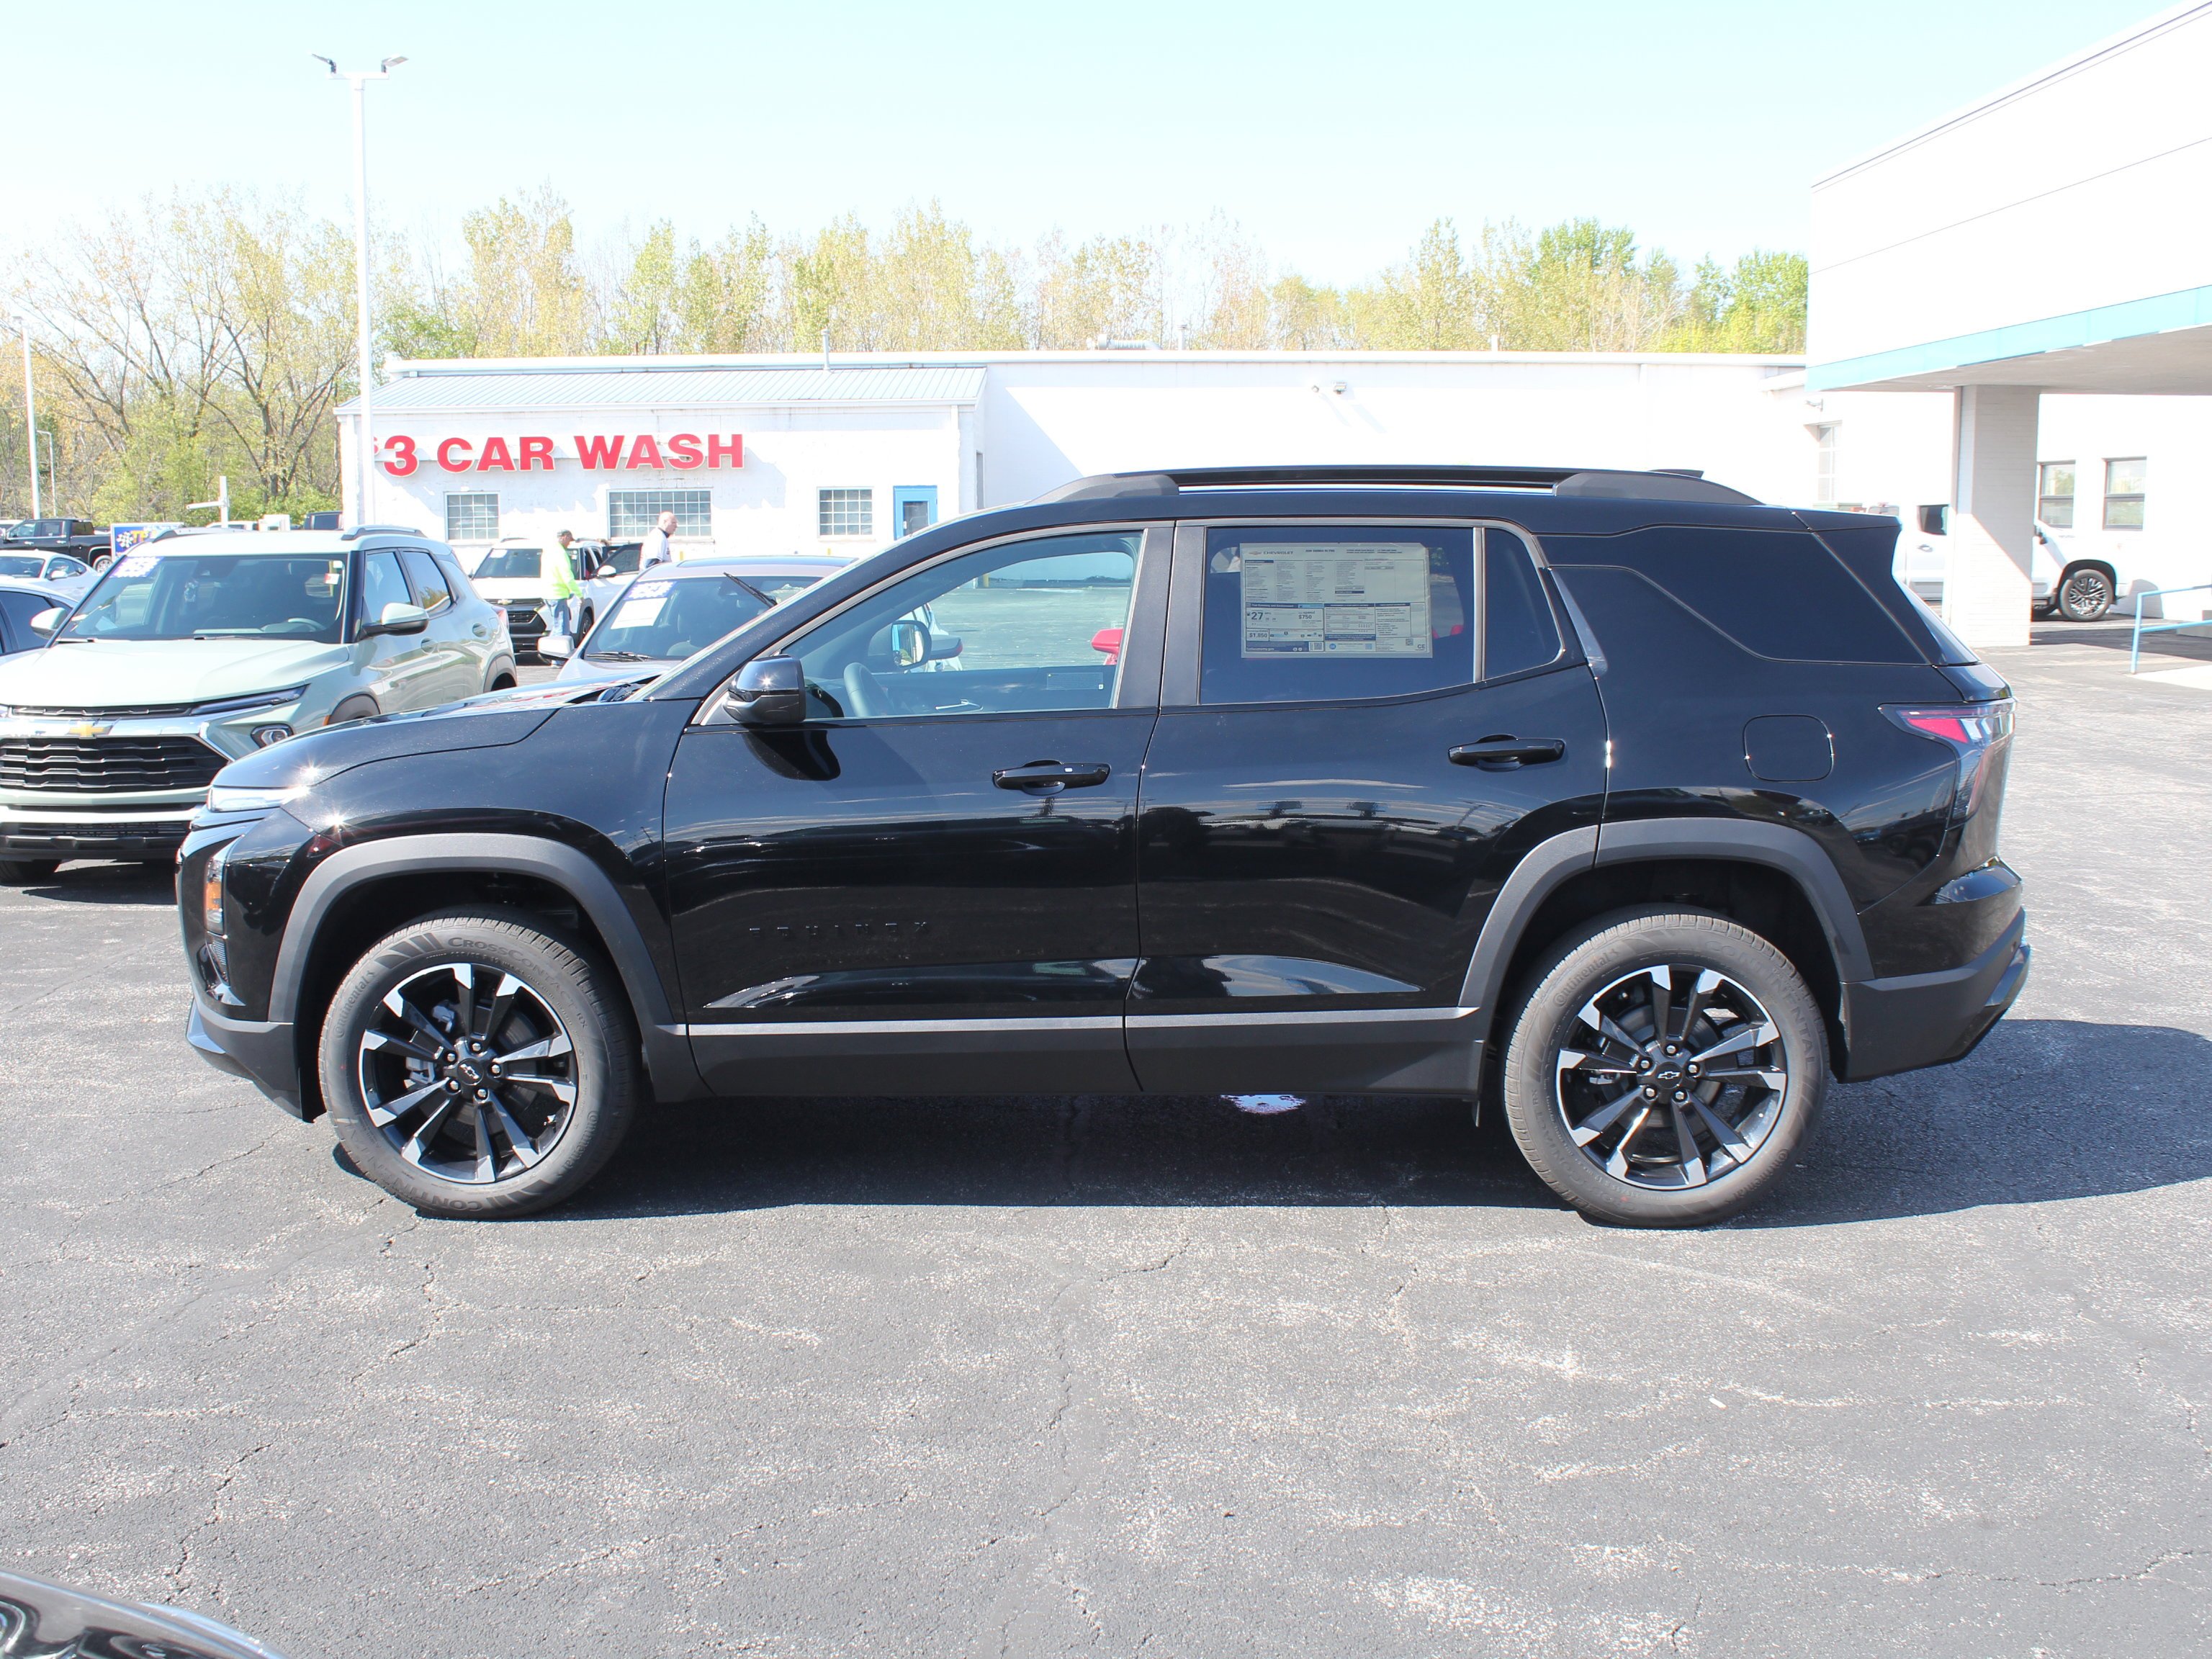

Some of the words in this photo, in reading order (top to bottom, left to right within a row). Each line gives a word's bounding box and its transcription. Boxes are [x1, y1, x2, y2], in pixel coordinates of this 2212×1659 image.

[437, 436, 554, 473] CAR
[574, 433, 744, 470] WASH
[1251, 611, 1264, 620] 27
[1553, 952, 1611, 1007] Continental
[333, 975, 370, 1039] Continental
